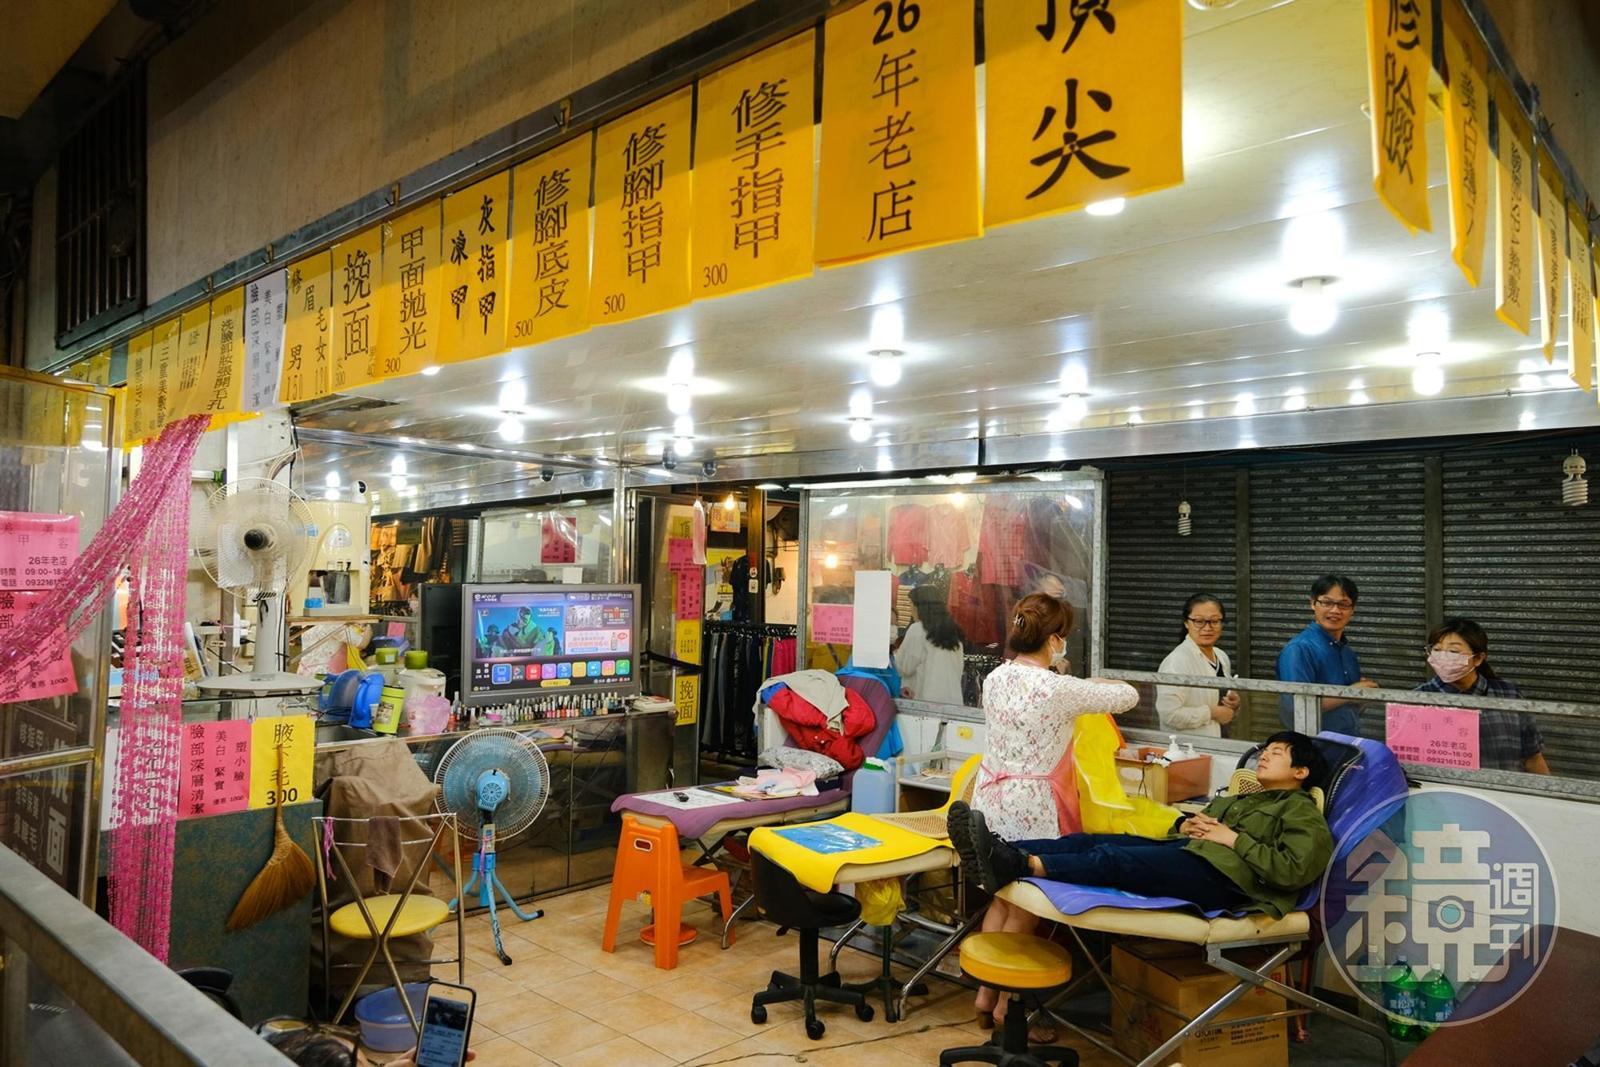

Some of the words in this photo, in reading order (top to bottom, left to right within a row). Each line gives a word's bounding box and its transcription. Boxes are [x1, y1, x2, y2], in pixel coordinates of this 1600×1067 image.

[730, 78, 790, 259] 修手指甲
[867, 0, 920, 242] 26年老店
[533, 168, 572, 319] 修腳底皮
[621, 123, 667, 284] 修腳指甲
[343, 249, 372, 361] 挽面
[450, 229, 469, 321] 凍甲
[476, 194, 497, 336] 灰指甲
[604, 293, 626, 316] 500
[703, 263, 728, 288] 300
[384, 357, 401, 373] 300
[515, 319, 534, 338] 500
[680, 680, 694, 721] 挽面
